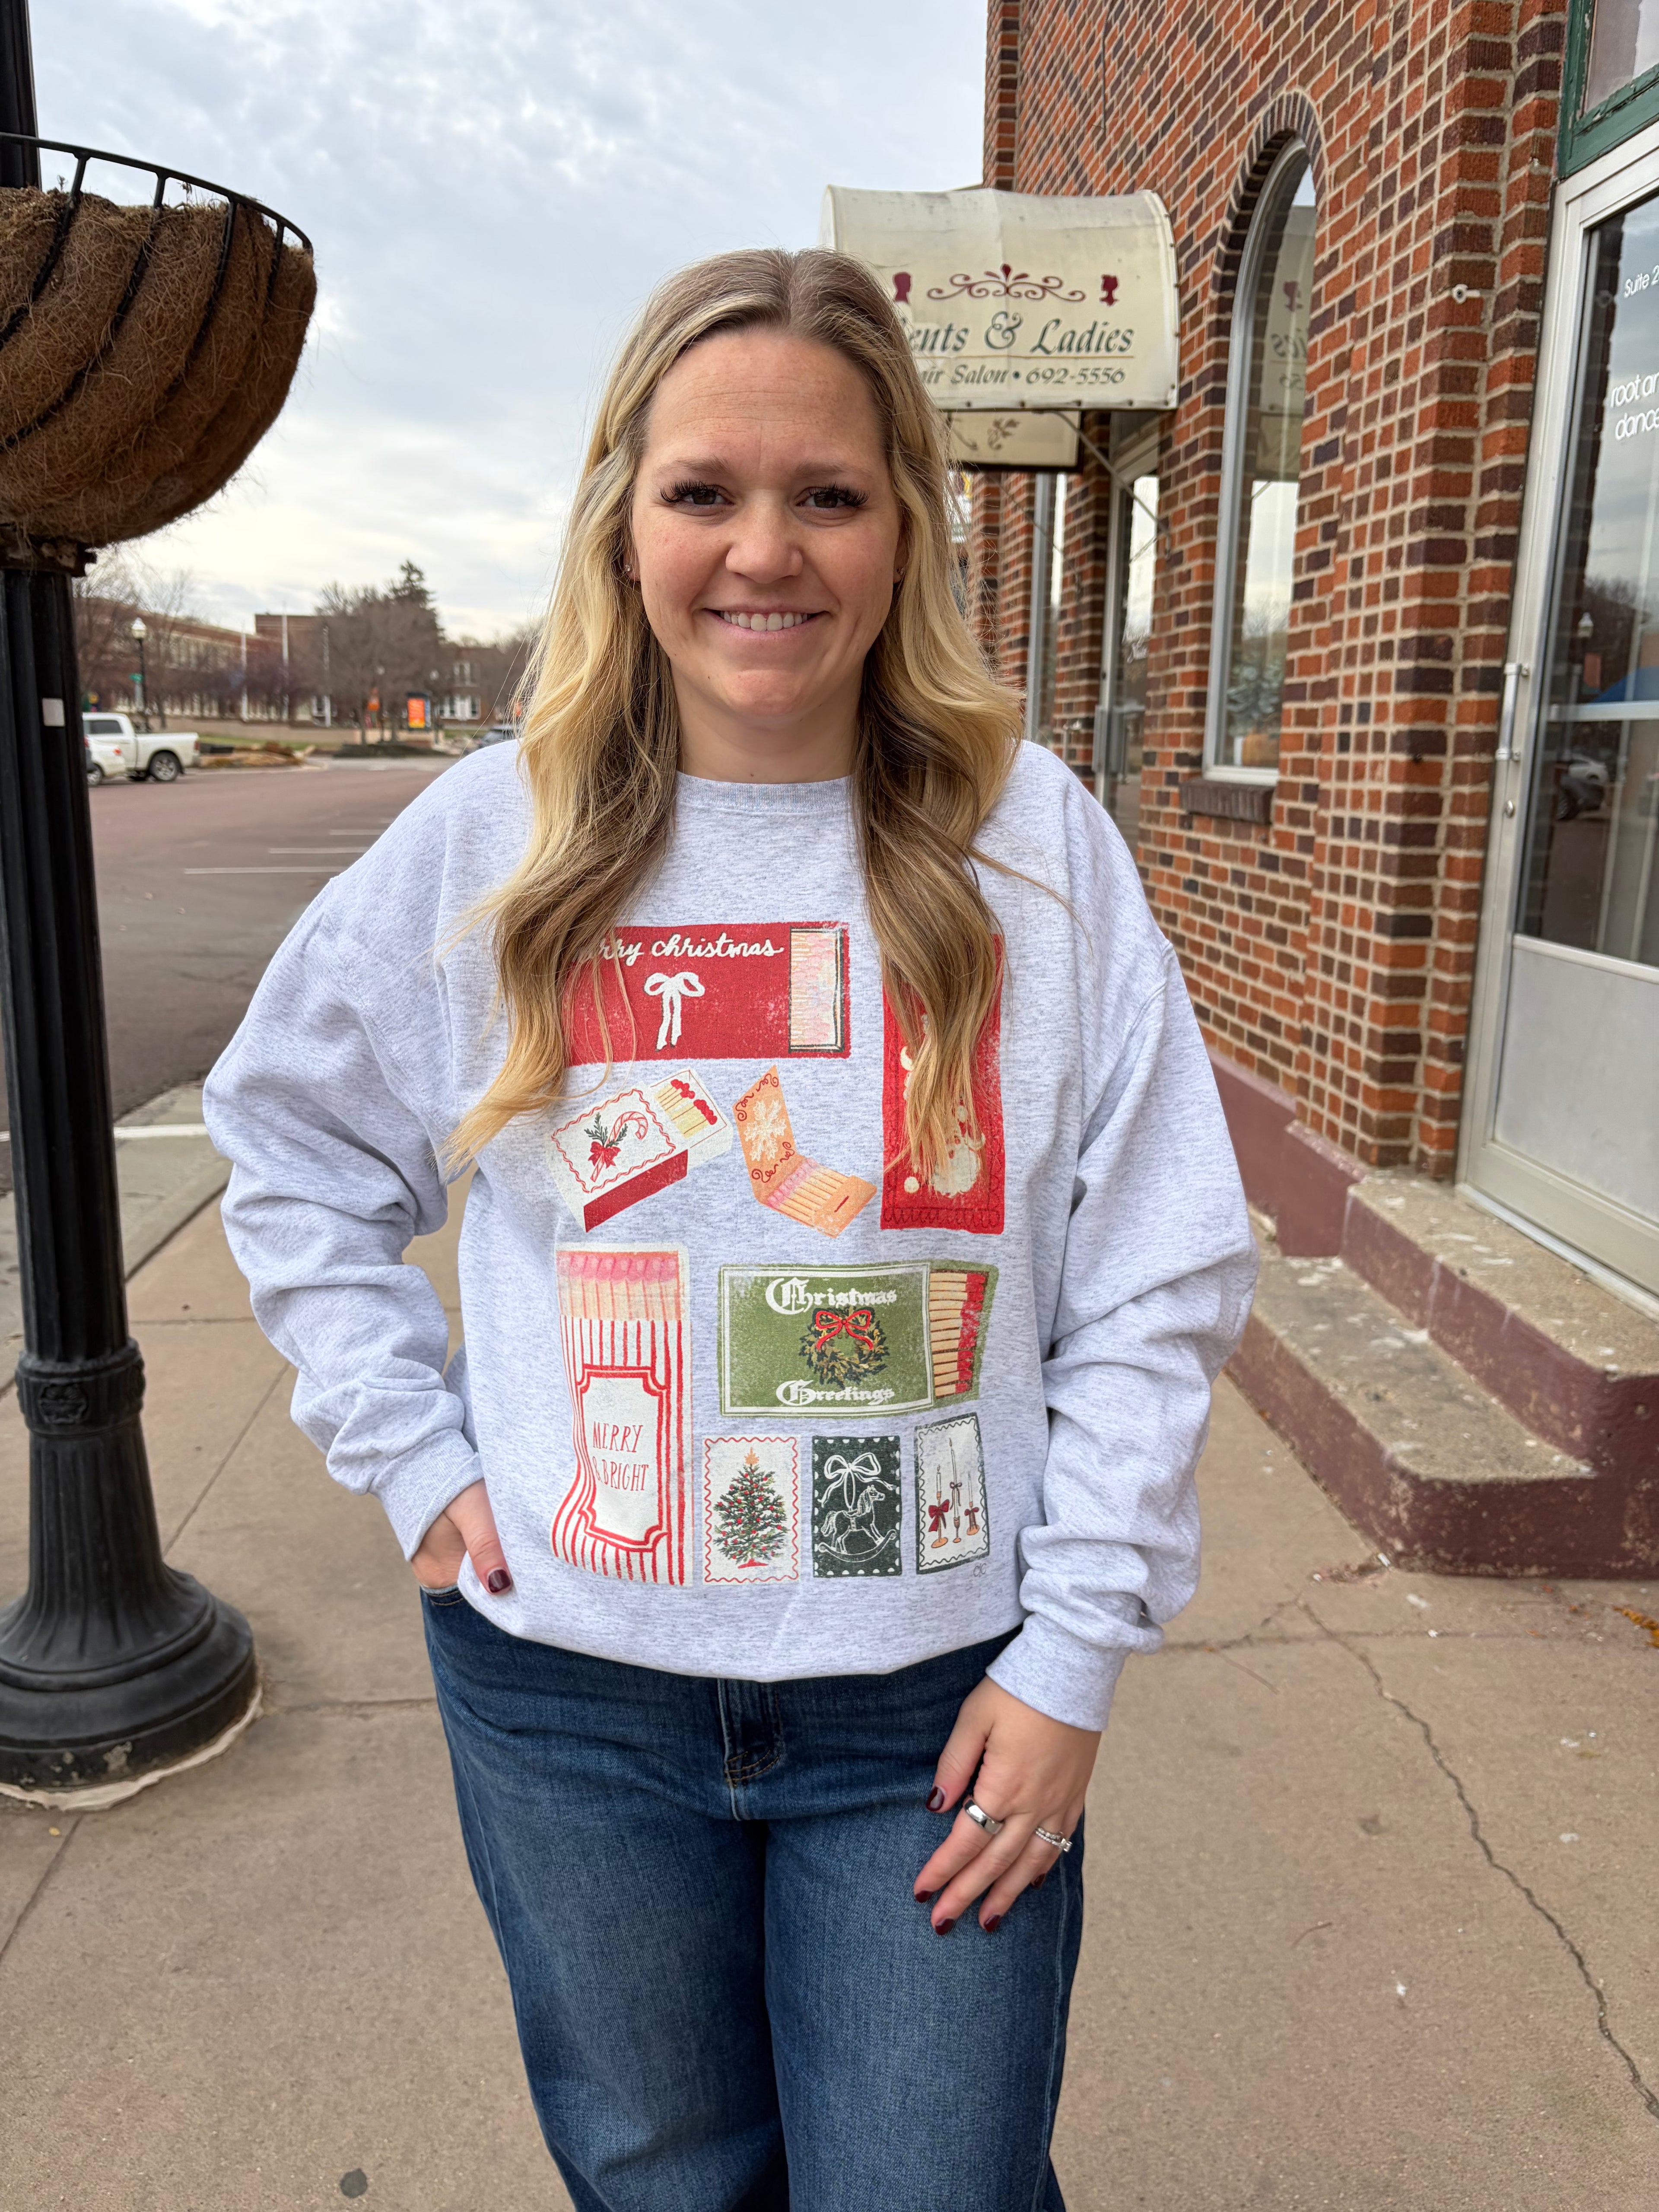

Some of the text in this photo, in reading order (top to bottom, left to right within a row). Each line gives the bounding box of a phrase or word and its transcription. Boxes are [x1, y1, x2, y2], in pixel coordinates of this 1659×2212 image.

[1624, 273, 1650, 298] Suite
[901, 311, 1135, 355] ents & Ladies
[920, 364, 1126, 385] air Salon 692-5556
[1611, 374, 1641, 408] root
[598, 932, 785, 967] rry christmas
[765, 1277, 897, 1315] Christmas
[775, 1379, 895, 1406] Greetings
[593, 1421, 643, 1452] MERRY
[602, 1459, 649, 1491] BRIGHT
